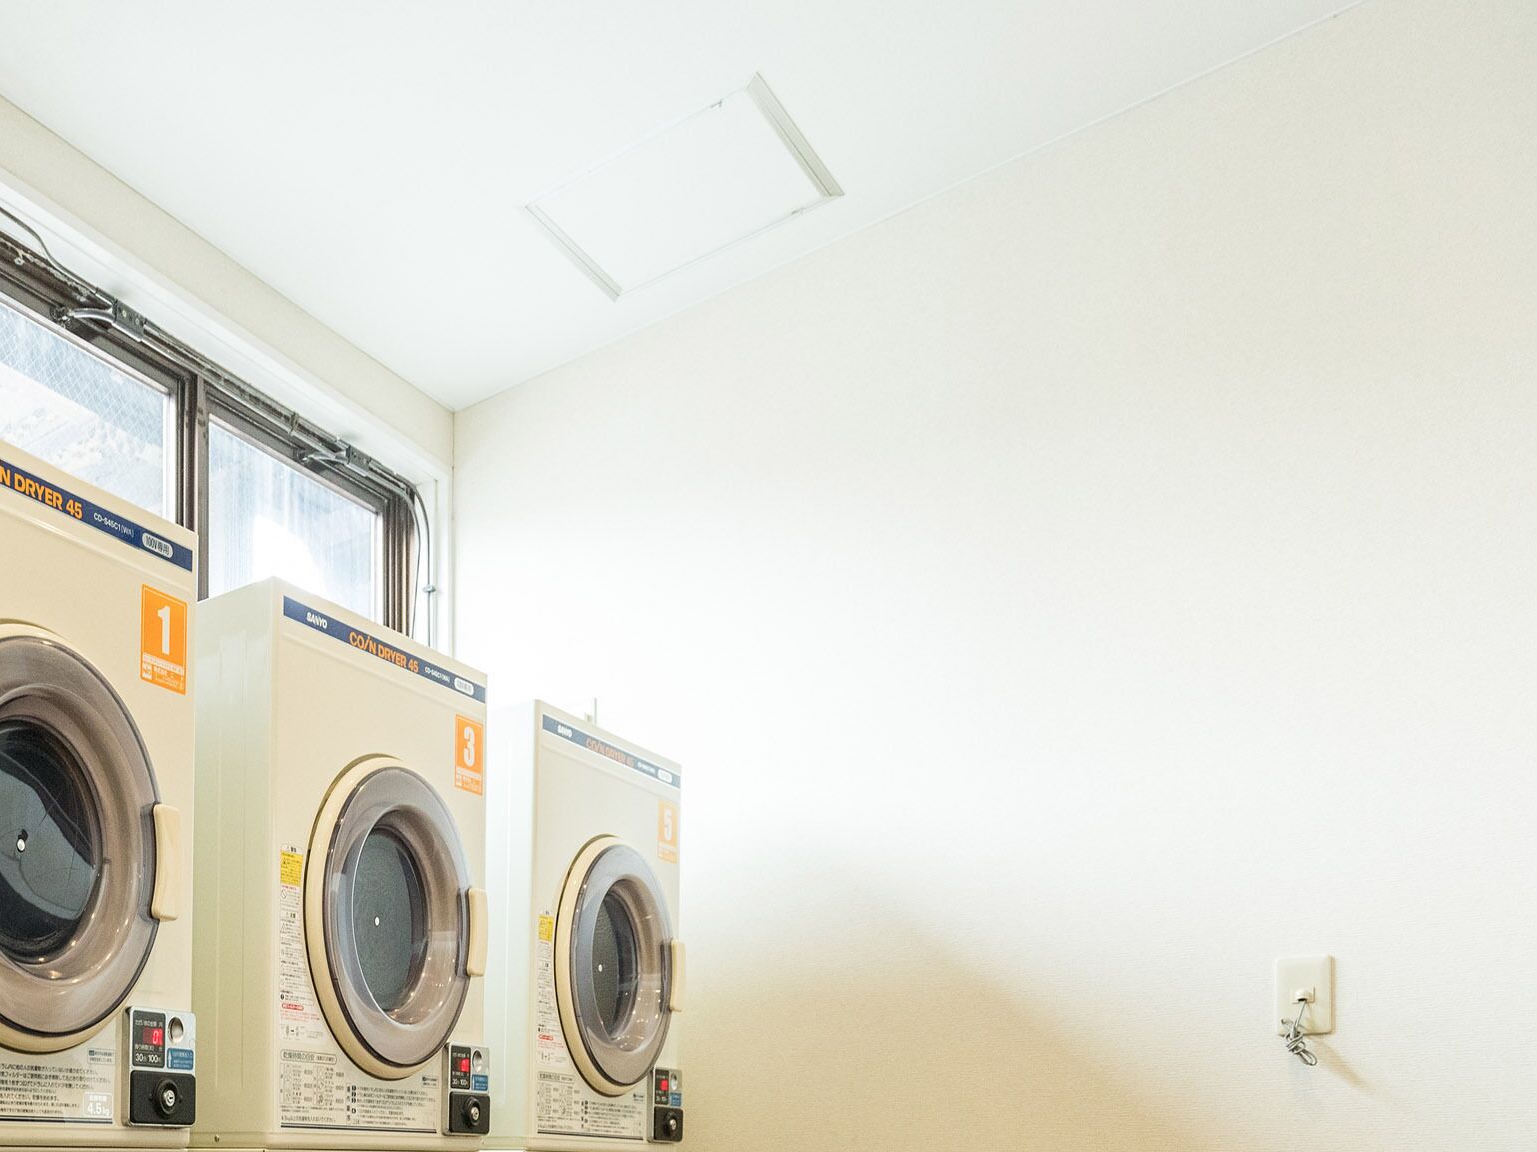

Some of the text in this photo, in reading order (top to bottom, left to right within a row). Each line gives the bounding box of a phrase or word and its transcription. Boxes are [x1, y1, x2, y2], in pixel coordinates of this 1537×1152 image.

[14, 472, 63, 512] DRYER
[65, 498, 83, 520] 45
[157, 605, 171, 656] 1
[306, 611, 328, 629] SANYO
[378, 645, 406, 668] DRYER
[409, 660, 419, 673] 45
[463, 726, 475, 767] 3
